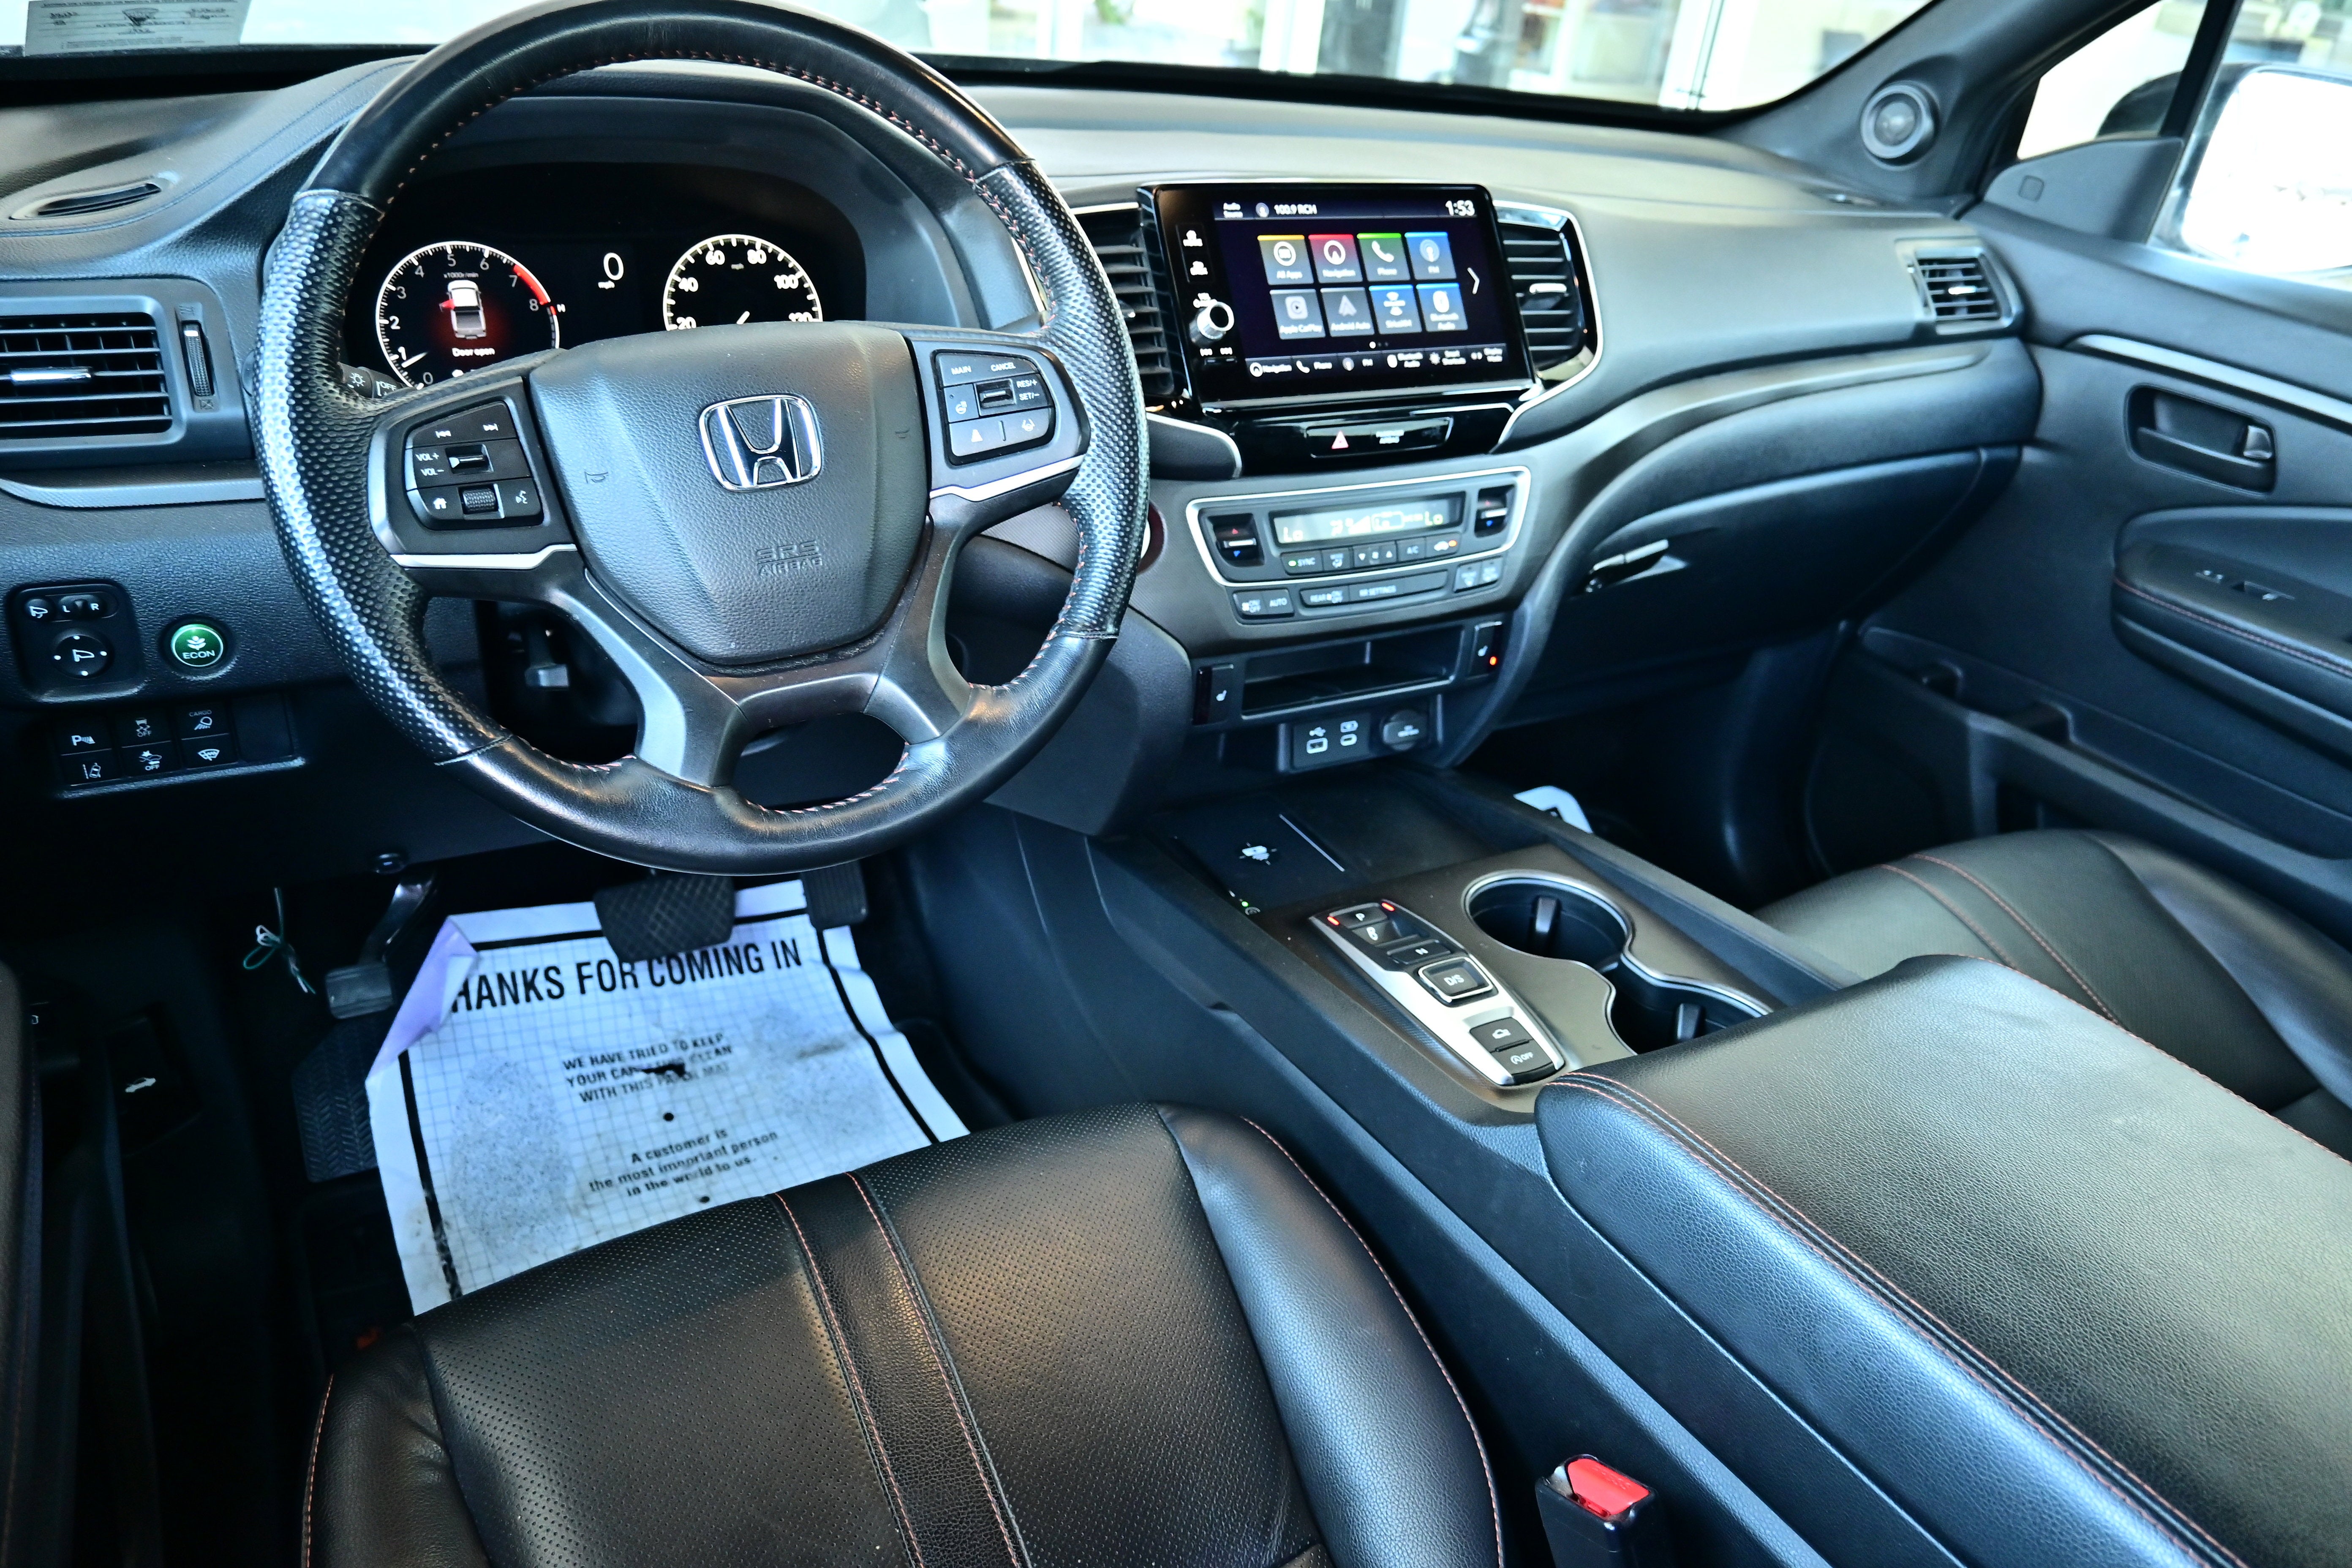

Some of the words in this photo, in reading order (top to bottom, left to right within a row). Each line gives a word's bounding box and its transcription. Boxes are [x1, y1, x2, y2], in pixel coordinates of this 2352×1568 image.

[1274, 204, 1297, 215] 100.9
[1445, 200, 1475, 216] 1:53
[448, 254, 456, 267] 5
[705, 250, 725, 265] 60
[747, 249, 767, 264] 80
[480, 259, 489, 270] 6
[603, 253, 623, 280] 0
[415, 266, 425, 278] 4
[509, 275, 517, 287] 7
[678, 278, 698, 291] 40
[774, 275, 798, 289] 100
[397, 286, 406, 299] 3
[529, 299, 539, 312] 8
[389, 316, 400, 329] 2
[676, 317, 696, 329] 20
[398, 346, 406, 360] 1
[452, 348, 473, 357] Door
[475, 348, 495, 357] open
[951, 365, 972, 375] MAIN
[991, 362, 1016, 372] CANCEL
[423, 372, 433, 384] 0
[380, 381, 397, 392] OFF
[756, 540, 819, 562] SRS
[1298, 557, 1315, 566] SYNC
[1269, 598, 1288, 607] AUTO
[182, 650, 215, 659] ECON
[451, 966, 565, 1013] HANKS
[576, 959, 639, 994] FOR
[648, 942, 764, 987] COMING
[771, 938, 801, 969] IN
[1444, 974, 1465, 986] D/S
[563, 1056, 585, 1070] WE
[589, 1051, 623, 1067] HAVE
[628, 1042, 669, 1059] TRIED
[672, 1039, 689, 1051] TO
[691, 1032, 724, 1048] KEEP
[566, 1071, 607, 1088] YOUR
[689, 1045, 732, 1063] CLEAN
[580, 1086, 618, 1102] WITH
[622, 1078, 653, 1094] THIS
[632, 1153, 642, 1163] A
[645, 1135, 710, 1160] customer
[715, 1129, 728, 1138] is
[589, 1179, 613, 1192] the
[618, 1168, 654, 1184] most
[659, 1146, 727, 1173] important
[731, 1132, 777, 1154] person
[627, 1185, 641, 1196] in
[645, 1179, 668, 1191] the
[673, 1165, 713, 1184] world
[715, 1162, 730, 1172] to
